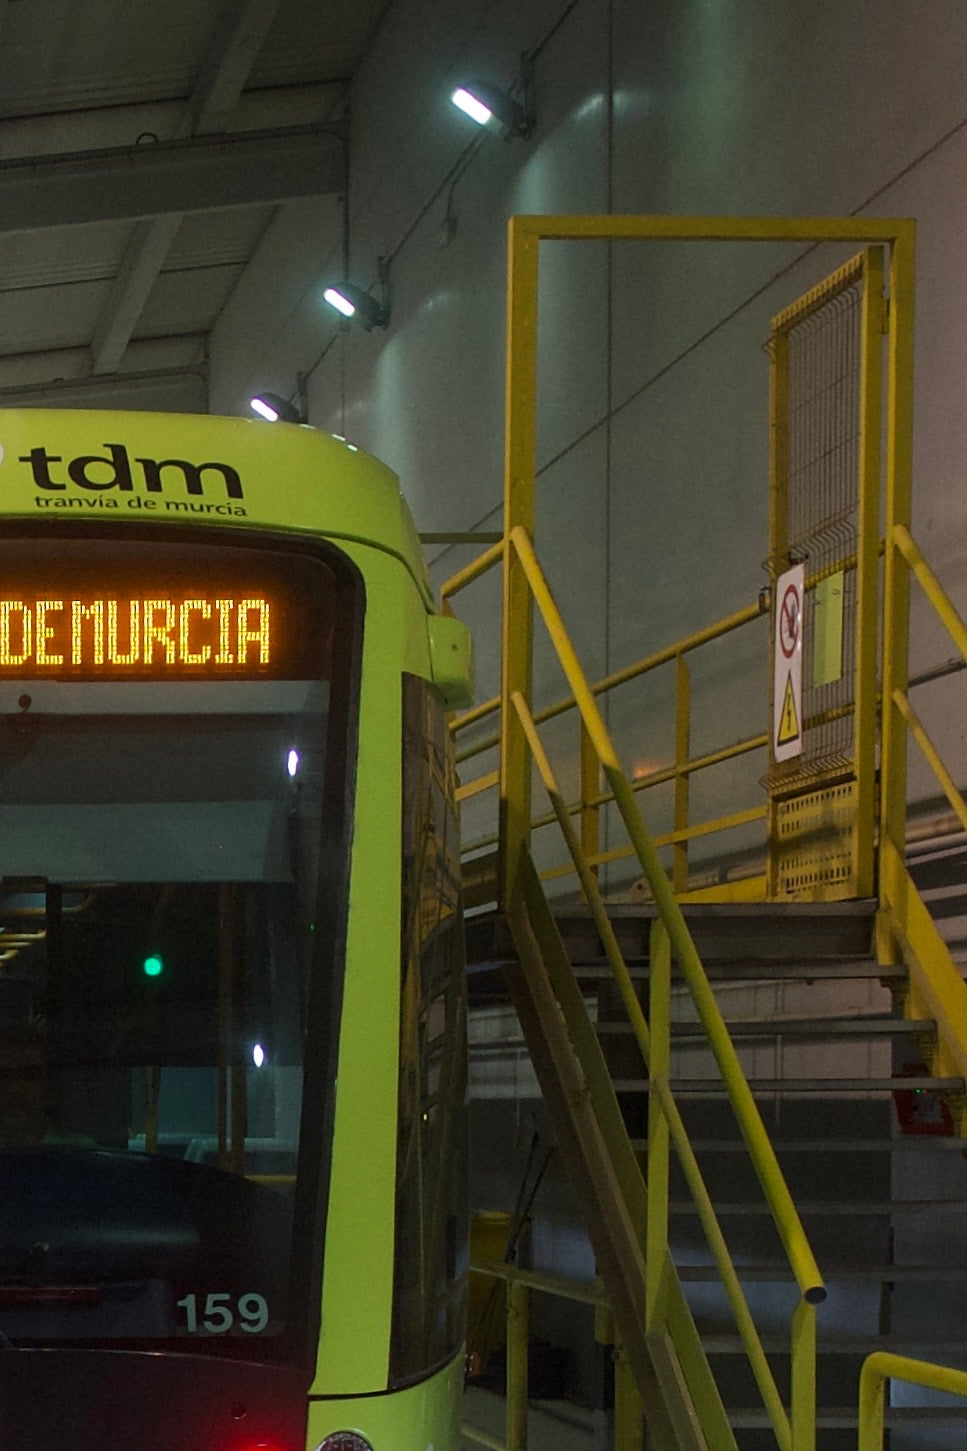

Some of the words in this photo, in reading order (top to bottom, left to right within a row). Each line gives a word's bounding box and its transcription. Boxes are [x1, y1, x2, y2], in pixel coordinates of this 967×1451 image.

[19, 443, 245, 499] tdm
[35, 494, 120, 509] tranvía
[127, 496, 157, 510] de
[165, 499, 248, 518] murcia
[176, 1292, 270, 1334] 159
